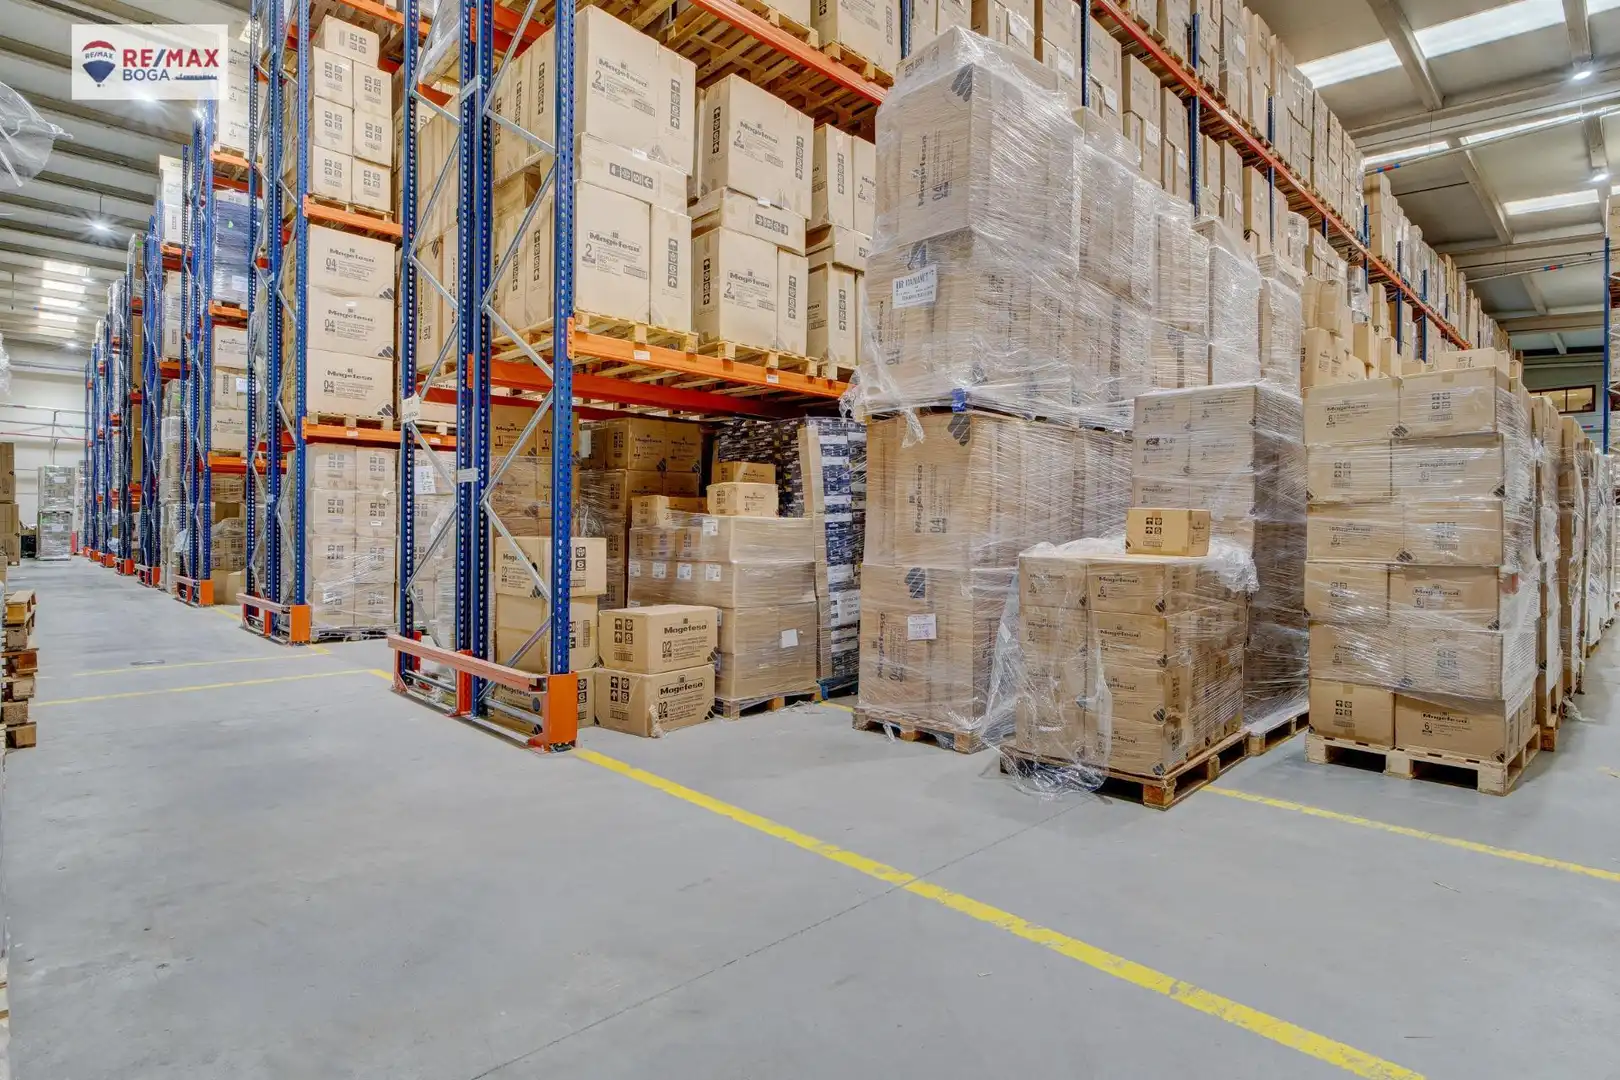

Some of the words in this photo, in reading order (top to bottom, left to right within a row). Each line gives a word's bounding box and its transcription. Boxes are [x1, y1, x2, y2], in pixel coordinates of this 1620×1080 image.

[594, 70, 603, 85] 2
[735, 130, 743, 143] 2
[589, 231, 641, 253] Magefesa
[584, 243, 593, 258] 2
[325, 257, 337, 269] 04
[729, 272, 770, 288] Magefesa
[725, 281, 732, 293] 2
[324, 319, 335, 330] 04
[323, 379, 335, 390] 04
[929, 518, 942, 533] 04
[663, 622, 708, 635] Magefesa
[661, 640, 672, 653] 02
[660, 681, 704, 696] Magefesa
[657, 701, 668, 715] 02
